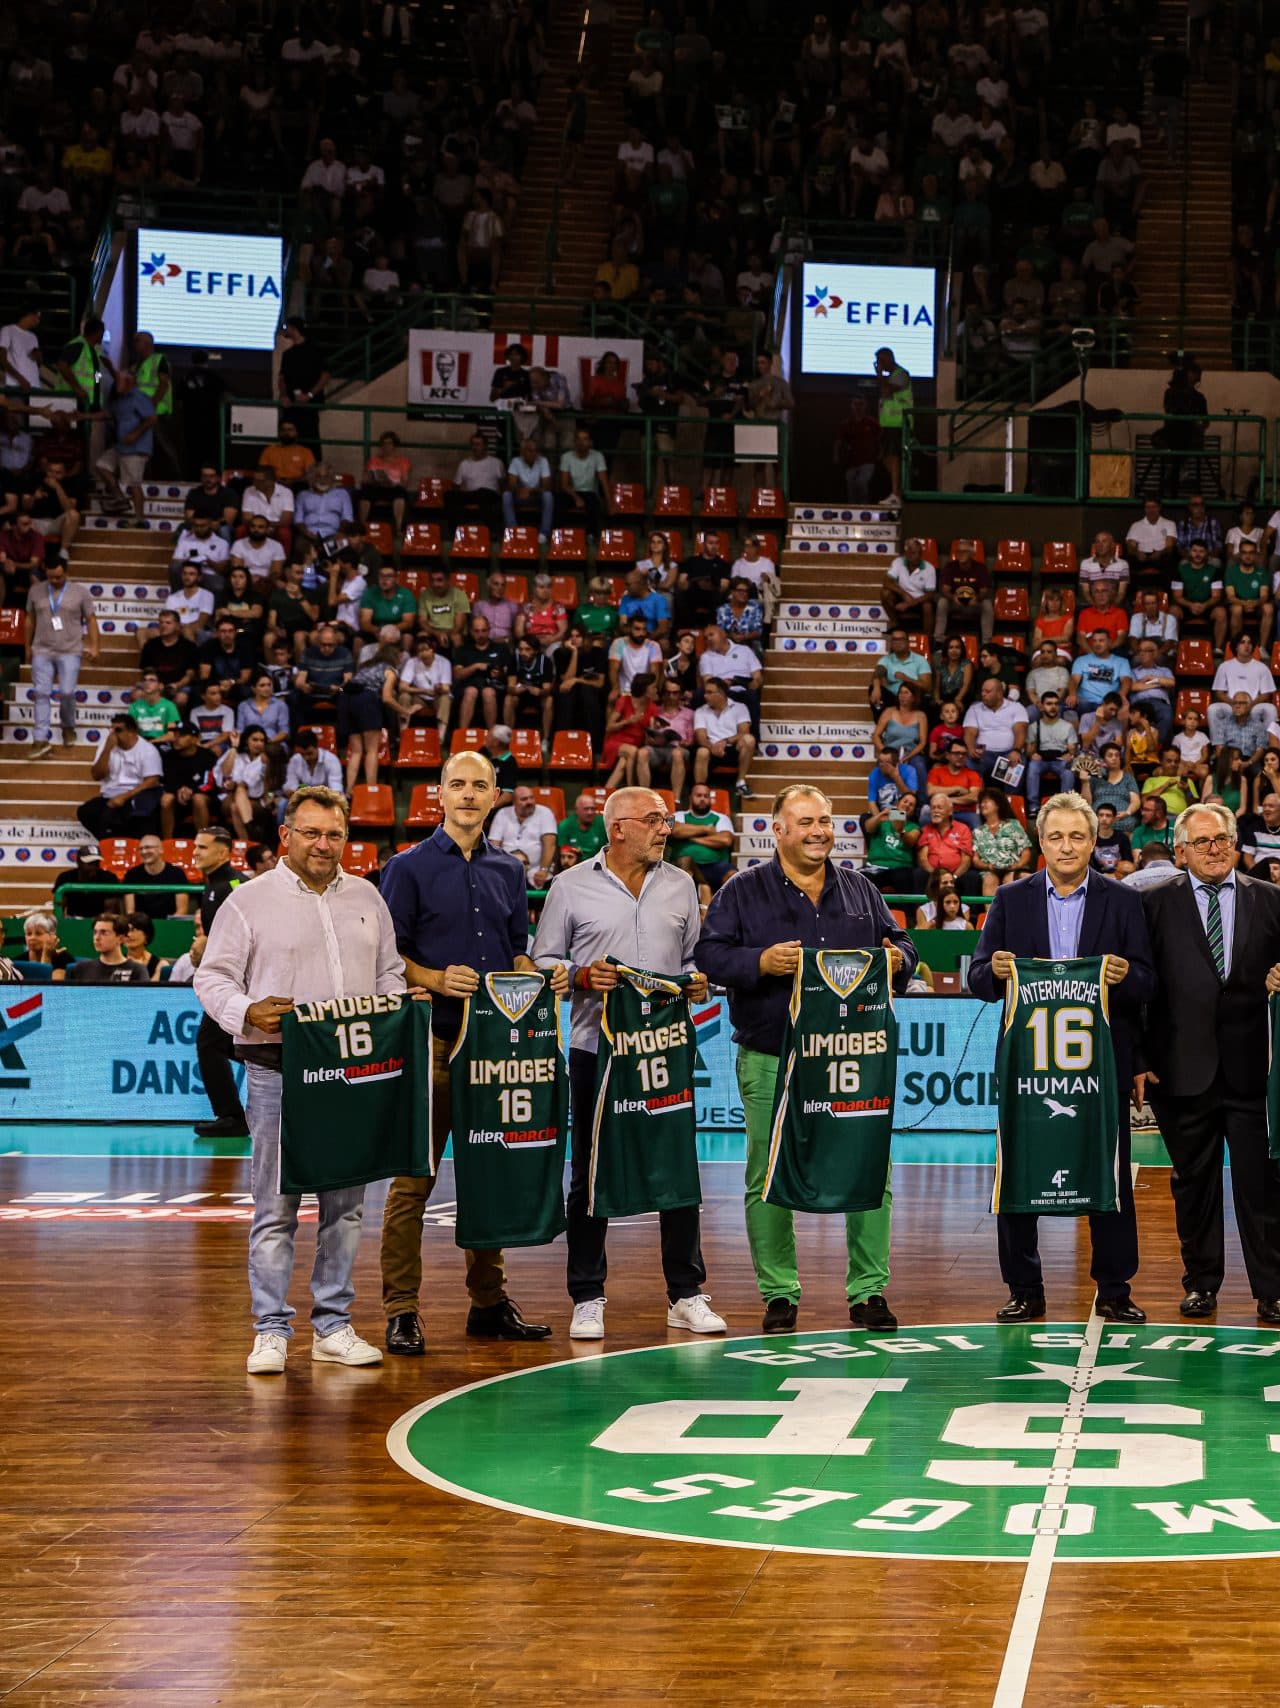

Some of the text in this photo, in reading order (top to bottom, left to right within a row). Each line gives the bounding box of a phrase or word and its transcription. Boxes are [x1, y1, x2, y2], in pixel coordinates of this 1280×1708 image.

[186, 270, 280, 298] EFFIA
[847, 302, 932, 326] EFFIA
[429, 388, 460, 399] KFC
[785, 621, 881, 634] Ville de Limoges
[767, 725, 794, 736] Ville
[818, 726, 869, 738] Limoges
[8, 826, 91, 842] de Limoges
[1020, 979, 1099, 1005] INTERMARCHE
[294, 992, 403, 1023] LIMOGES
[335, 1021, 373, 1059] 16
[801, 1029, 888, 1058] LIMOGES
[1025, 1007, 1094, 1071] 16
[636, 1056, 670, 1092] 16
[826, 1060, 860, 1094] 16
[1018, 1076, 1099, 1095] HUMAN
[498, 1088, 533, 1124] 16
[724, 1334, 985, 1366] 1929
